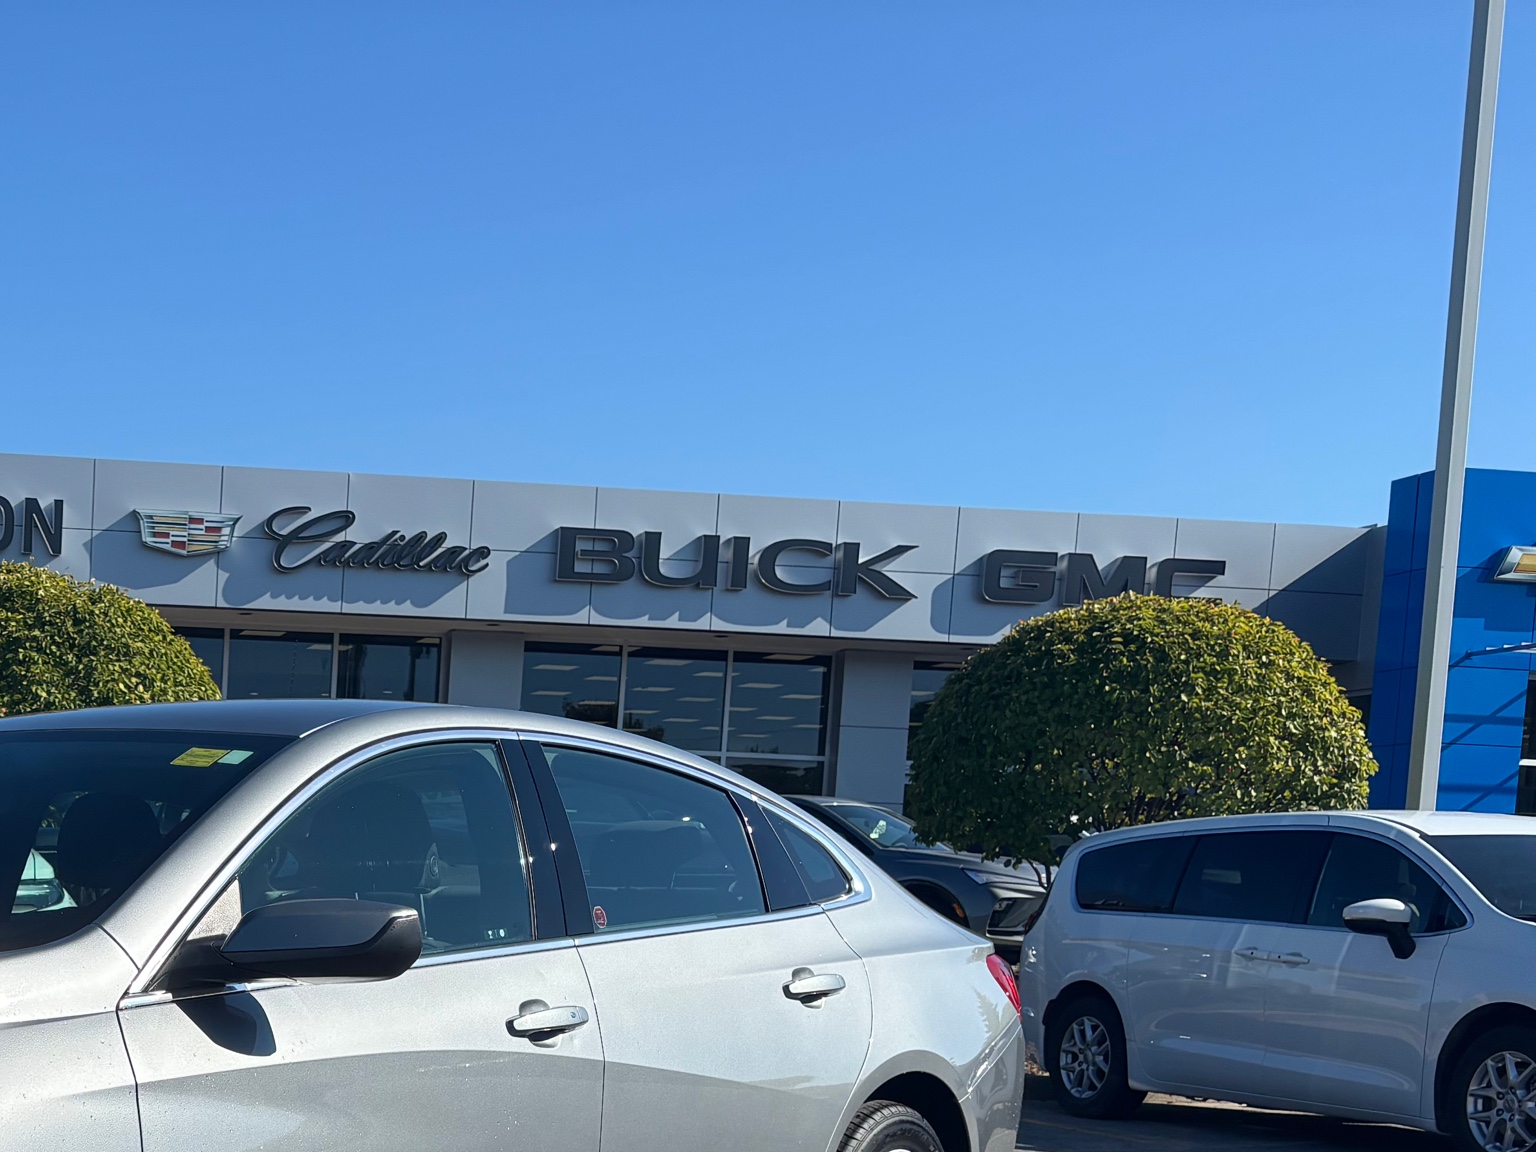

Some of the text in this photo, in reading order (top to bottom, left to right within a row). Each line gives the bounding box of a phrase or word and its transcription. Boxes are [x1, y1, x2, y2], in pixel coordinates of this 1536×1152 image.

[264, 505, 491, 575] Cadillac
[555, 526, 920, 600] BUICK
[981, 549, 1227, 606] GMC
